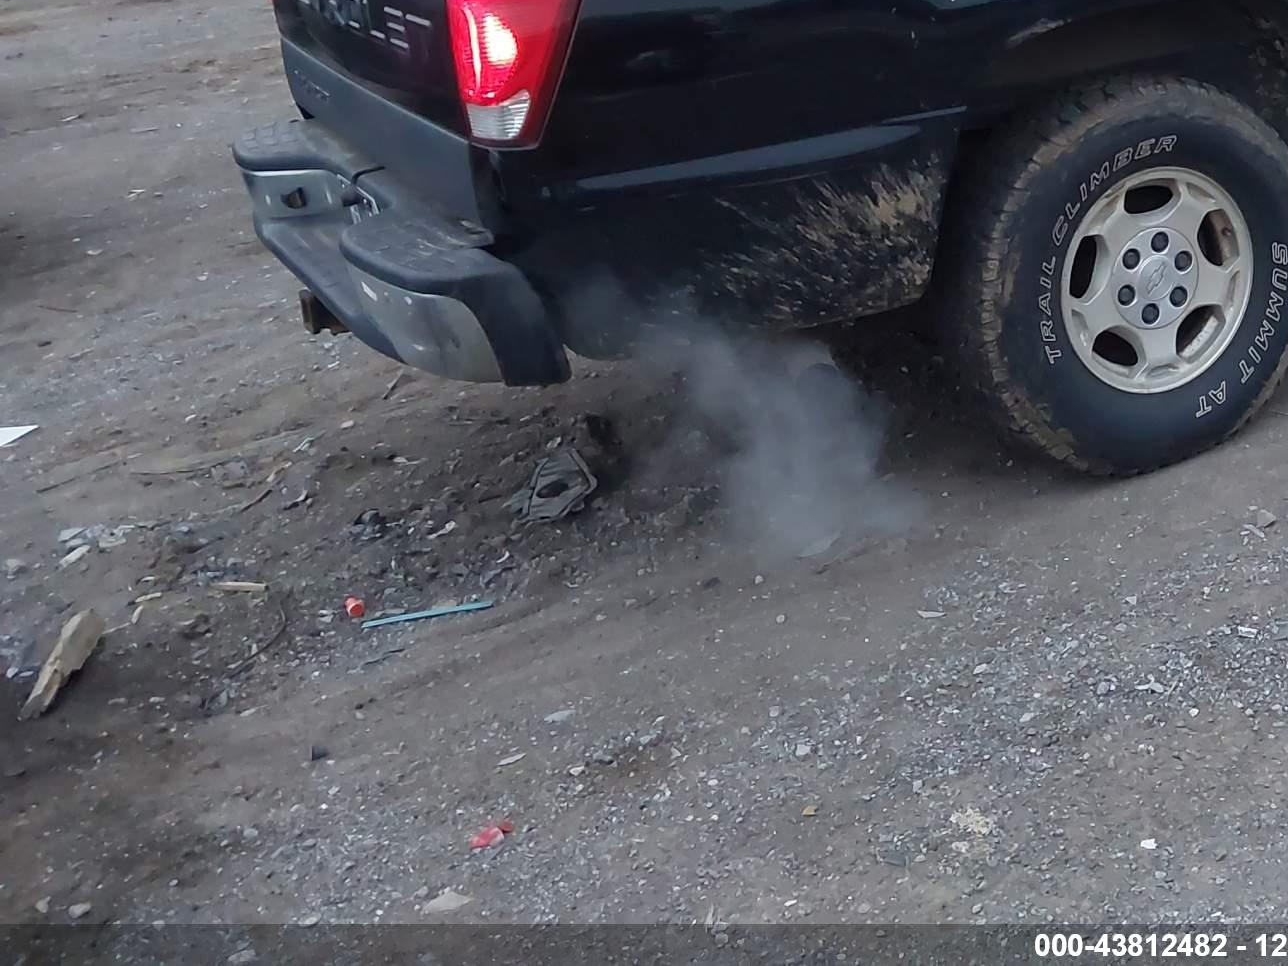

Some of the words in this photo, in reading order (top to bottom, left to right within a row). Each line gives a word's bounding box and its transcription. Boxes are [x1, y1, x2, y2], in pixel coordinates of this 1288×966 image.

[1038, 255, 1062, 365] TRAIL
[1052, 134, 1178, 246] CLIMBER
[1195, 380, 1228, 418] AT
